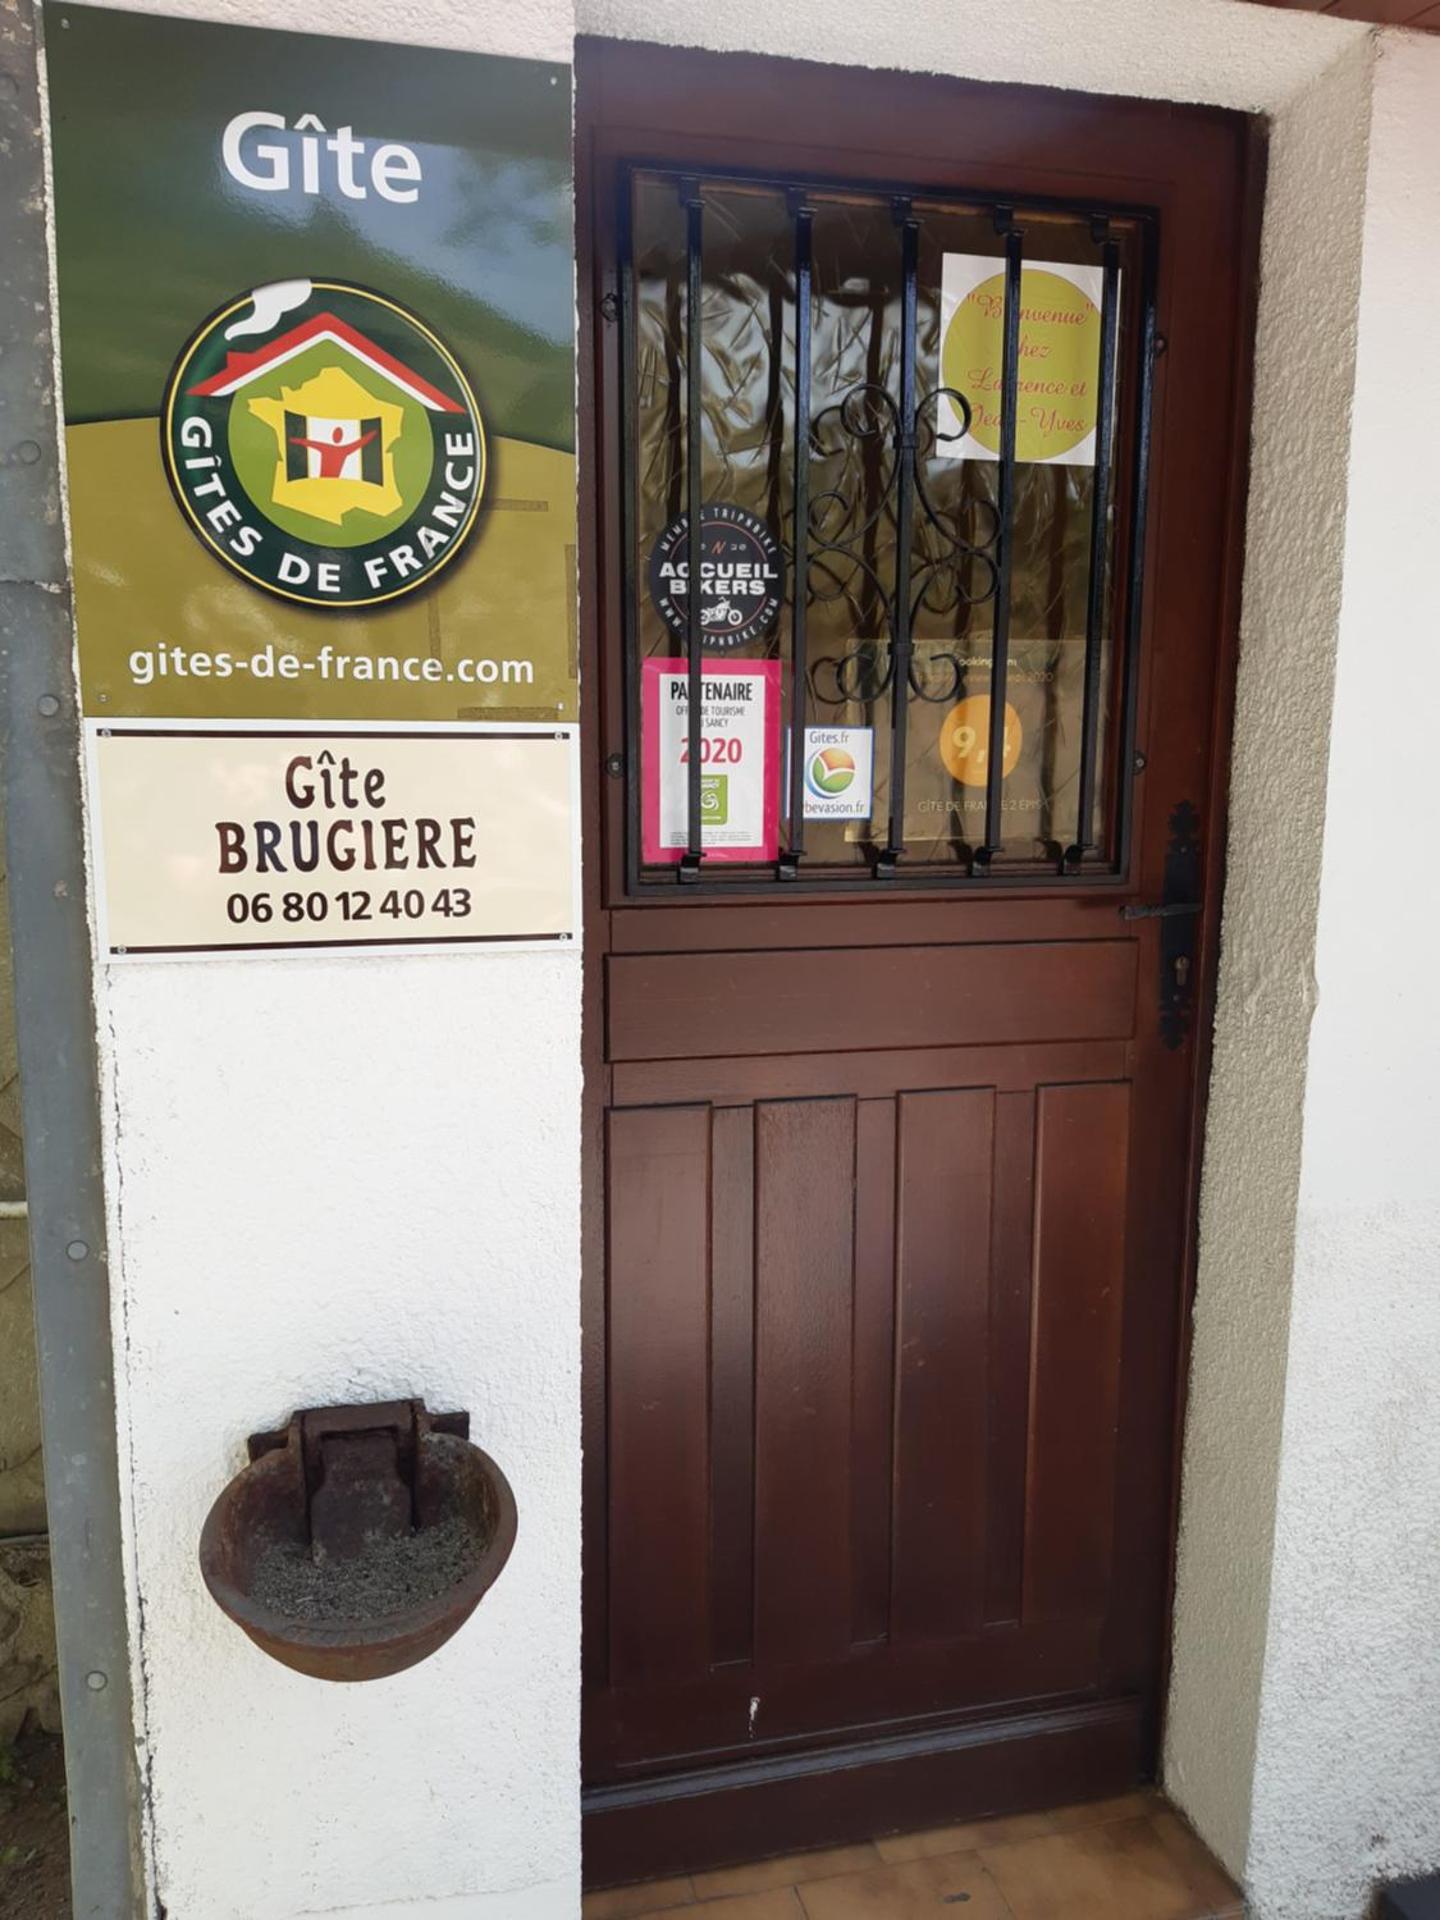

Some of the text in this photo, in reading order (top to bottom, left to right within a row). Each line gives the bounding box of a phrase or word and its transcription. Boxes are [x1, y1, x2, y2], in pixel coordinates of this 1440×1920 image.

[221, 111, 422, 204] Gîte
[967, 293, 1095, 326] "Bnvenue"
[1018, 333, 1051, 359] hez
[1070, 380, 1088, 397] et
[181, 416, 474, 592] GÎTES DE FRANCE
[659, 562, 779, 579] ACCUEIL
[669, 579, 766, 596] BKERS
[129, 643, 534, 684] gites-de-france.com
[671, 681, 753, 701] PATENAIRE
[285, 750, 386, 809] Gîte
[804, 800, 864, 815] bevasion.fr
[215, 817, 477, 874] BRUGIERE
[227, 888, 472, 923] 06 80 12 40 43
